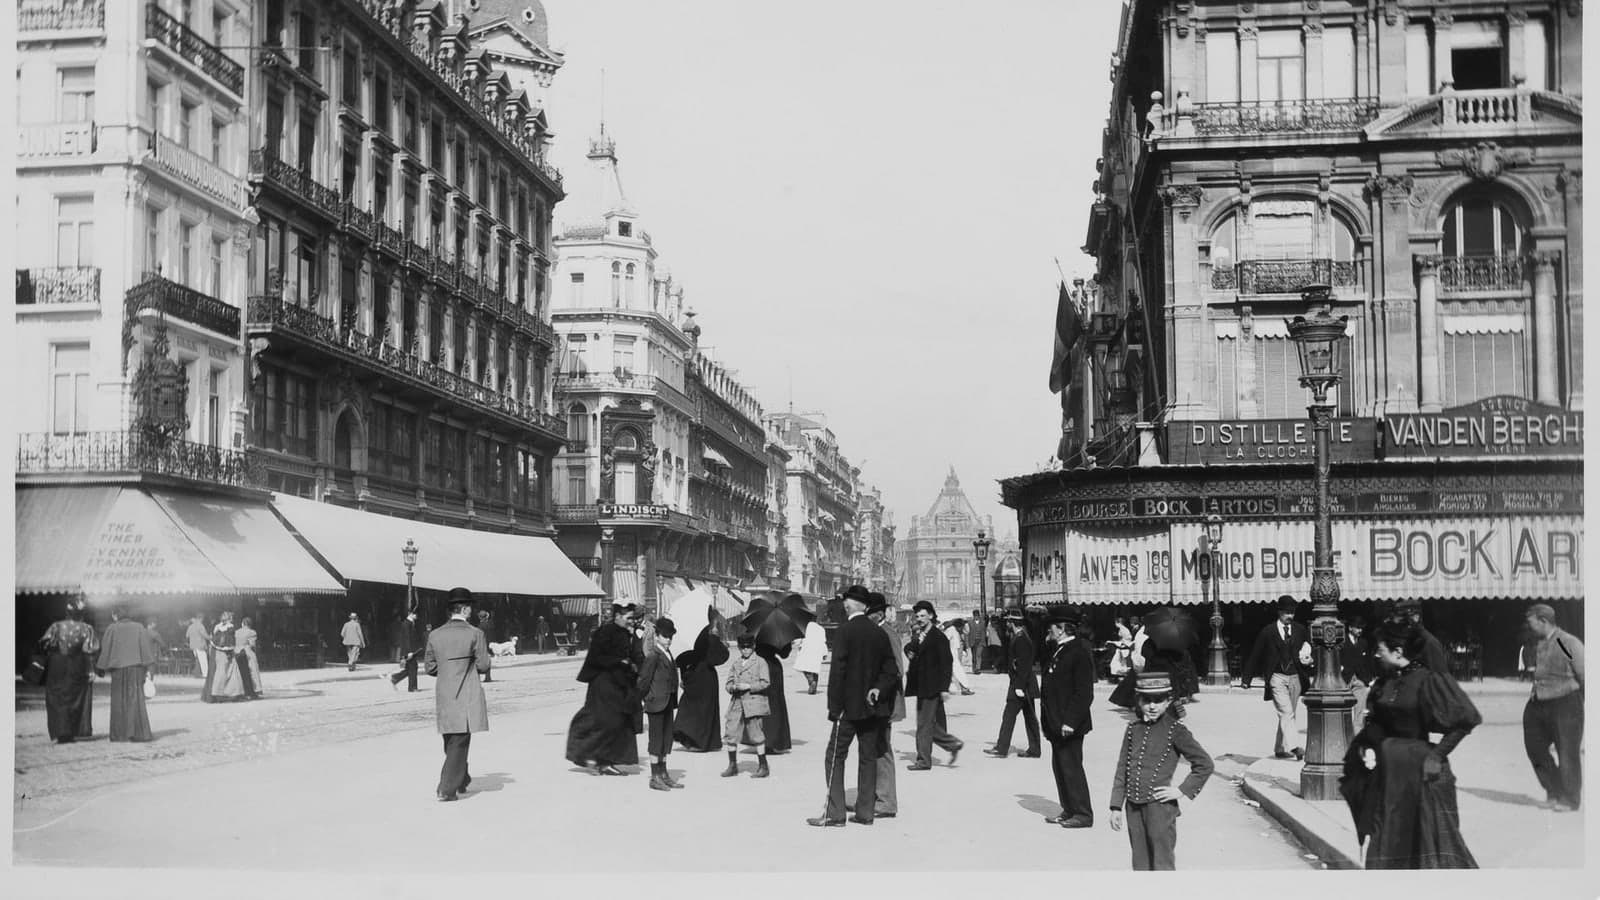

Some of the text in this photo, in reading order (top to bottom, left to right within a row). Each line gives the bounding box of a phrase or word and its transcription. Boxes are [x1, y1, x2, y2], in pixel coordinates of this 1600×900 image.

[1480, 397, 1529, 412] AGENCE
[1193, 422, 1353, 444] DISTILLEIE
[1388, 416, 1485, 446] VANDEN
[1225, 446, 1245, 459] LA
[1072, 503, 1129, 519] BOURSE
[1144, 498, 1277, 515] BOCK ARTOIS
[107, 522, 136, 533] THE
[1369, 528, 1585, 582] BOCK AR
[1080, 552, 1140, 584] ANVERS
[1181, 548, 1344, 583] MONICO BOURE
